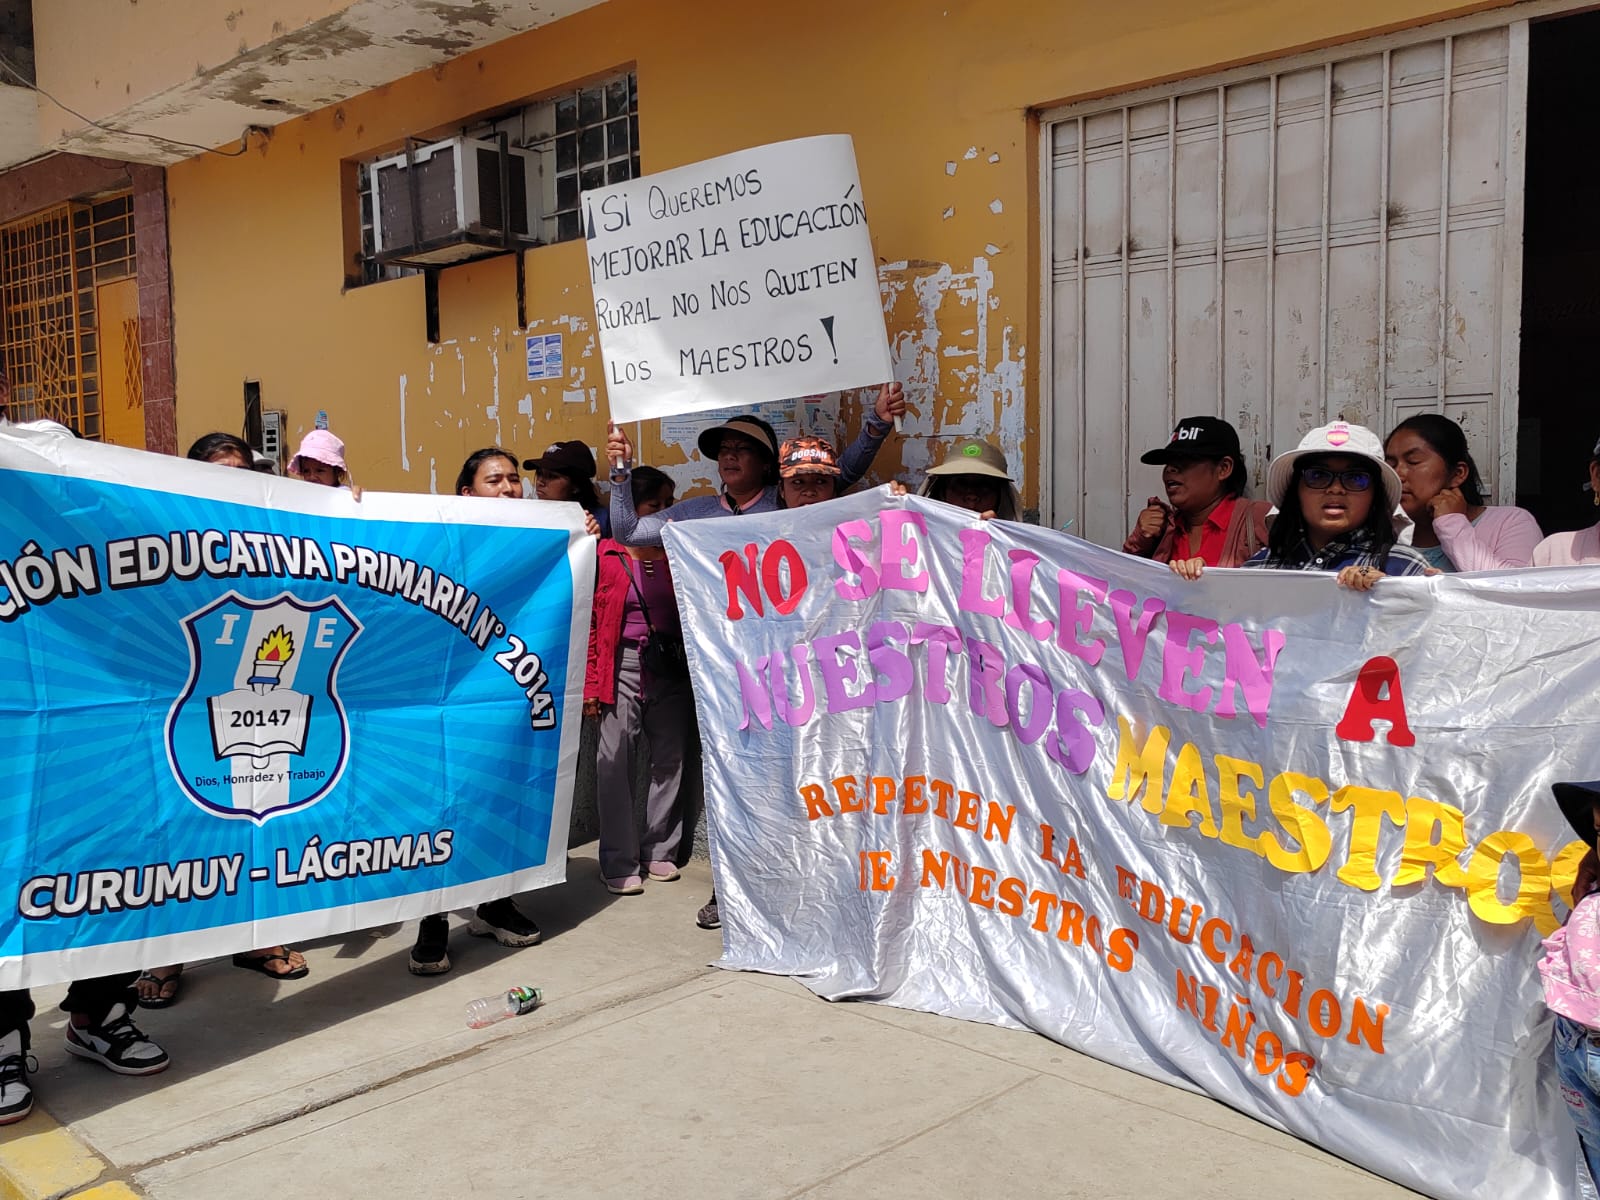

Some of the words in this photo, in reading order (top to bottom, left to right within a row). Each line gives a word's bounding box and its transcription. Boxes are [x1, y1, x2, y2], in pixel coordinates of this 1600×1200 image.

[591, 233, 693, 284] MEJORAR
[699, 227, 730, 257] LA
[739, 184, 867, 248] EDUCACIÓN
[648, 169, 762, 220] QUEREMOS
[596, 297, 661, 332] RURAL
[672, 292, 700, 318] NO
[711, 280, 751, 310] NOS
[765, 258, 858, 298] QUITEN
[611, 360, 652, 385] LOS
[107, 530, 333, 591] EDUCATIVA
[331, 542, 479, 634] PRIMARIA
[493, 634, 556, 731] 20147
[215, 614, 241, 645] I
[314, 617, 338, 649] E
[718, 539, 809, 621] NO
[831, 509, 930, 601] SE
[957, 528, 1287, 729] LLEVEN
[1335, 655, 1416, 748] A
[230, 709, 291, 728] 20147
[735, 620, 1106, 776] NUESTROS
[195, 776, 221, 787] Dios,
[223, 773, 275, 785] Honradez
[277, 775, 284, 783] y
[287, 769, 326, 781] Trabajo
[18, 854, 244, 921] CURUMUY
[275, 829, 455, 887] LÁGRIMAS
[919, 848, 1140, 973] NUESTROS
[1175, 967, 1317, 1098] NIÑOS
[1039, 823, 1088, 880] LA
[1115, 864, 1392, 1055] EDUCACION
